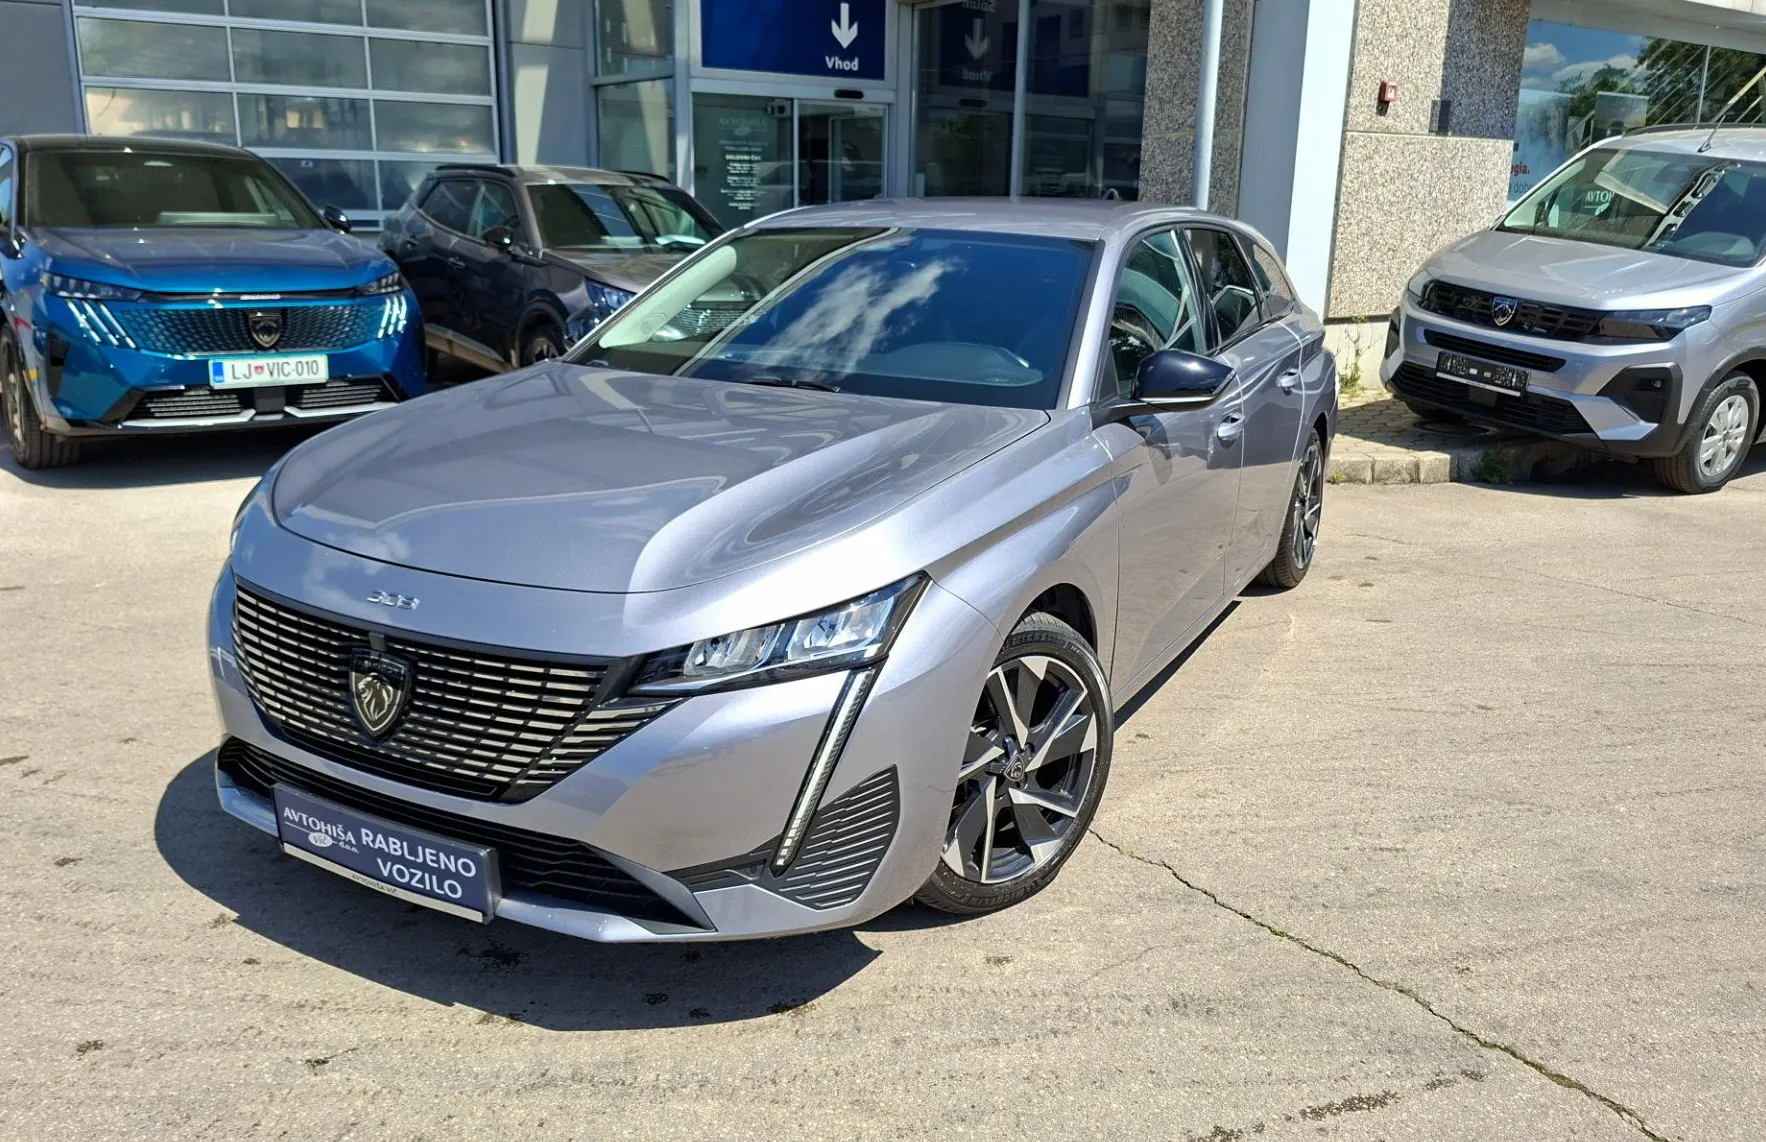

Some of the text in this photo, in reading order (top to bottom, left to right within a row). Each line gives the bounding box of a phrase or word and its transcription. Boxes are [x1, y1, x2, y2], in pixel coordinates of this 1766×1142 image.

[825, 56, 859, 71] Vhod
[231, 359, 319, 380] LJ VIC-010
[283, 807, 356, 845] AVTOHIŠA
[360, 827, 477, 878] RABLJENO
[376, 857, 463, 899] VOZILO
